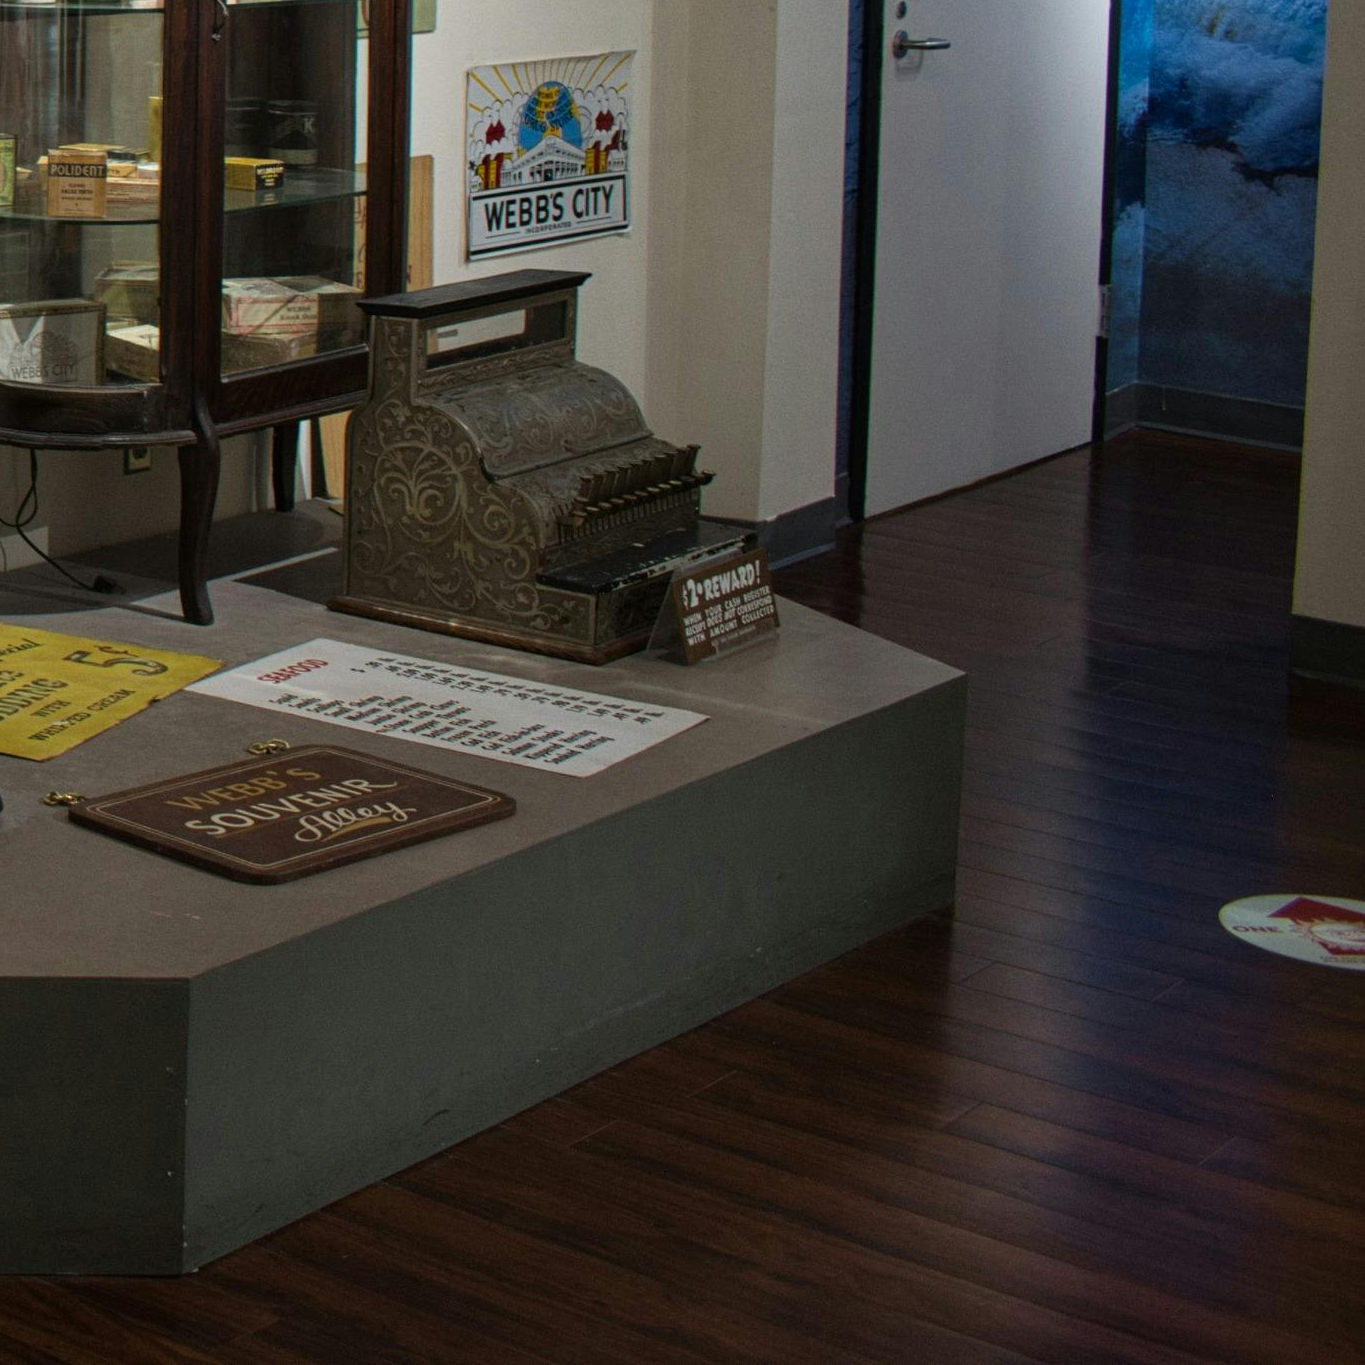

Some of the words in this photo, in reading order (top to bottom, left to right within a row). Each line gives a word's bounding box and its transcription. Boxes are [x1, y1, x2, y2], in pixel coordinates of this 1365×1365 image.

[50, 164, 105, 176] POLIDENT
[484, 191, 564, 233] WEBB'S
[572, 184, 615, 219] CITY
[703, 559, 761, 601] REWARD!
[683, 612, 702, 627] WHEN
[704, 604, 723, 620] YOUR
[724, 595, 741, 611] CASH
[743, 585, 771, 603] REGISTER
[685, 621, 707, 637] RECEIPT
[707, 613, 723, 627] DOES
[736, 596, 773, 616] CORRESPOND
[687, 632, 706, 647] WITH
[709, 619, 738, 638] AMOUNT
[740, 605, 774, 625] COLLECTED
[257, 658, 330, 685] SEAFOOD
[30, 700, 72, 719] WITH
[86, 689, 136, 712] CREAM
[165, 767, 322, 811] WEBB'S
[184, 778, 398, 836] SOUVENIR
[293, 800, 417, 842] Alley
